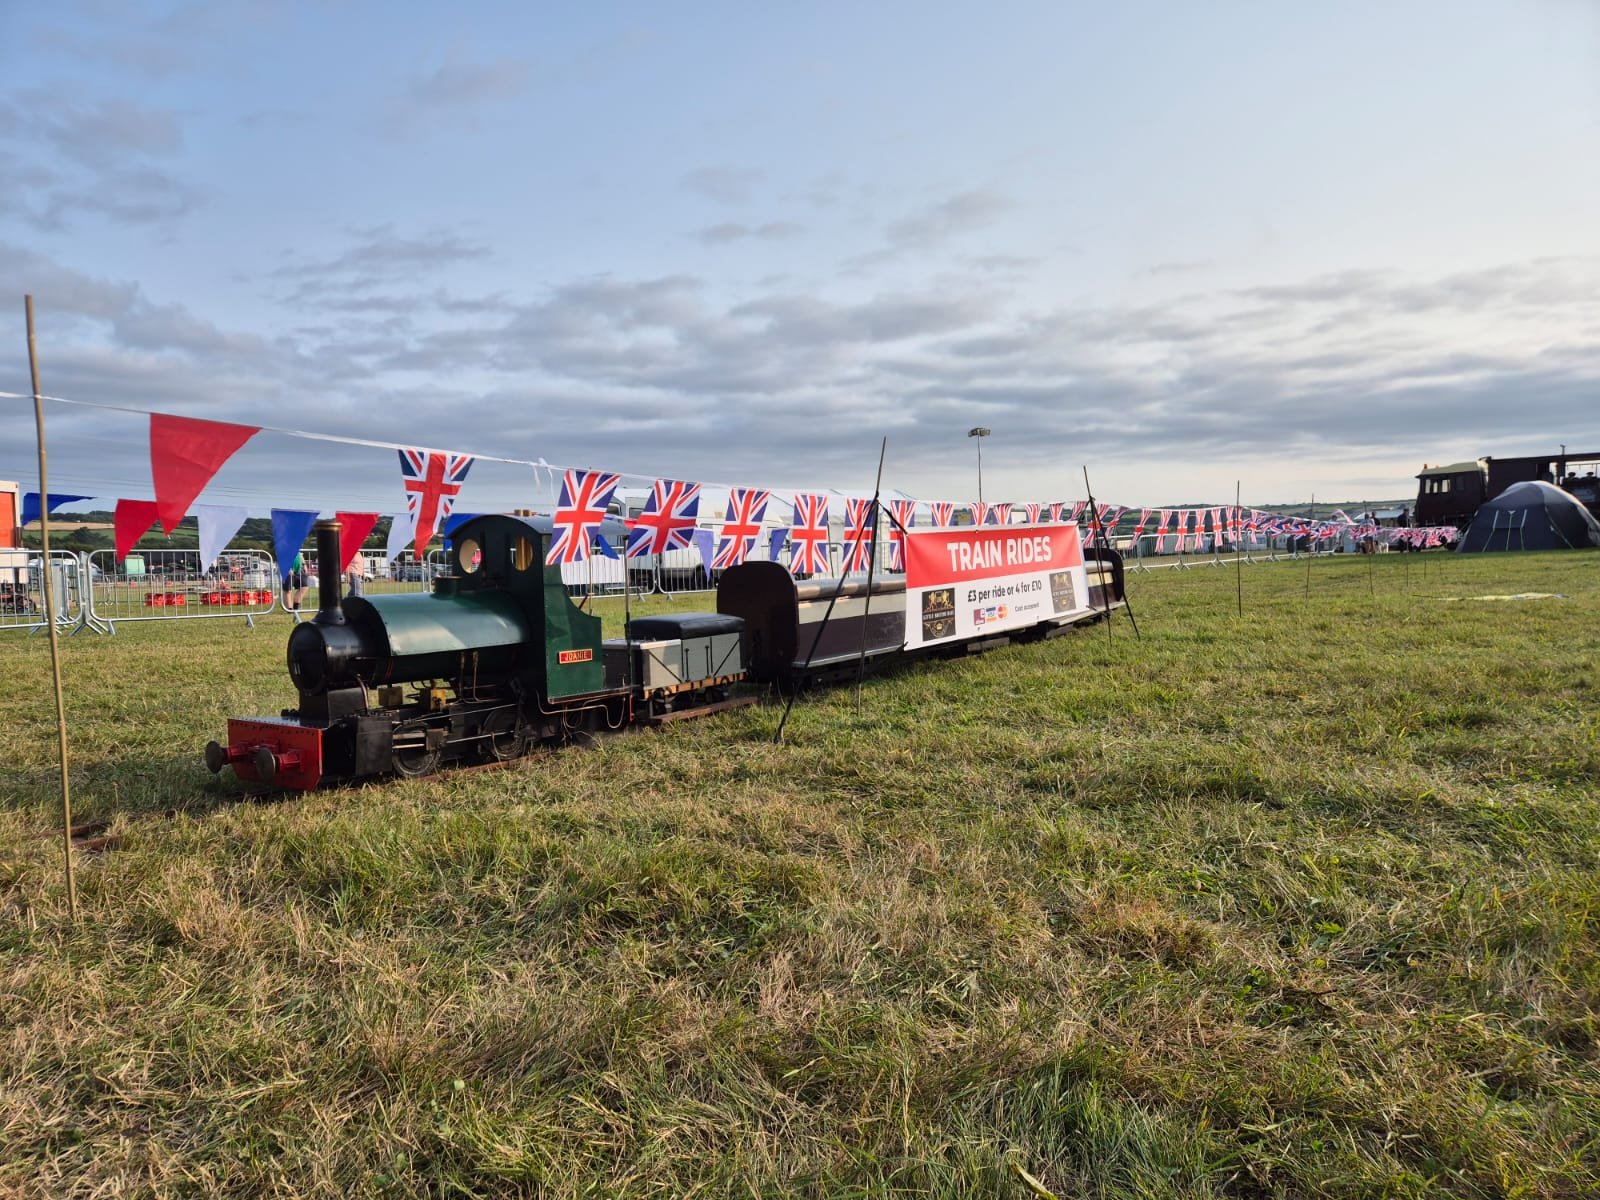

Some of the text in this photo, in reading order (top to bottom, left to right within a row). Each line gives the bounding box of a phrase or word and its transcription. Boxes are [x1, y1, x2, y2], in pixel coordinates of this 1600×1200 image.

[947, 536, 1052, 572] TRAIN RIDES
[967, 590, 977, 602] £3
[978, 591, 991, 603] per
[992, 585, 1006, 598] ride
[1015, 584, 1020, 593] 4
[1021, 582, 1030, 592] for
[1031, 580, 1042, 591] £10
[565, 650, 591, 661] JOANIE
